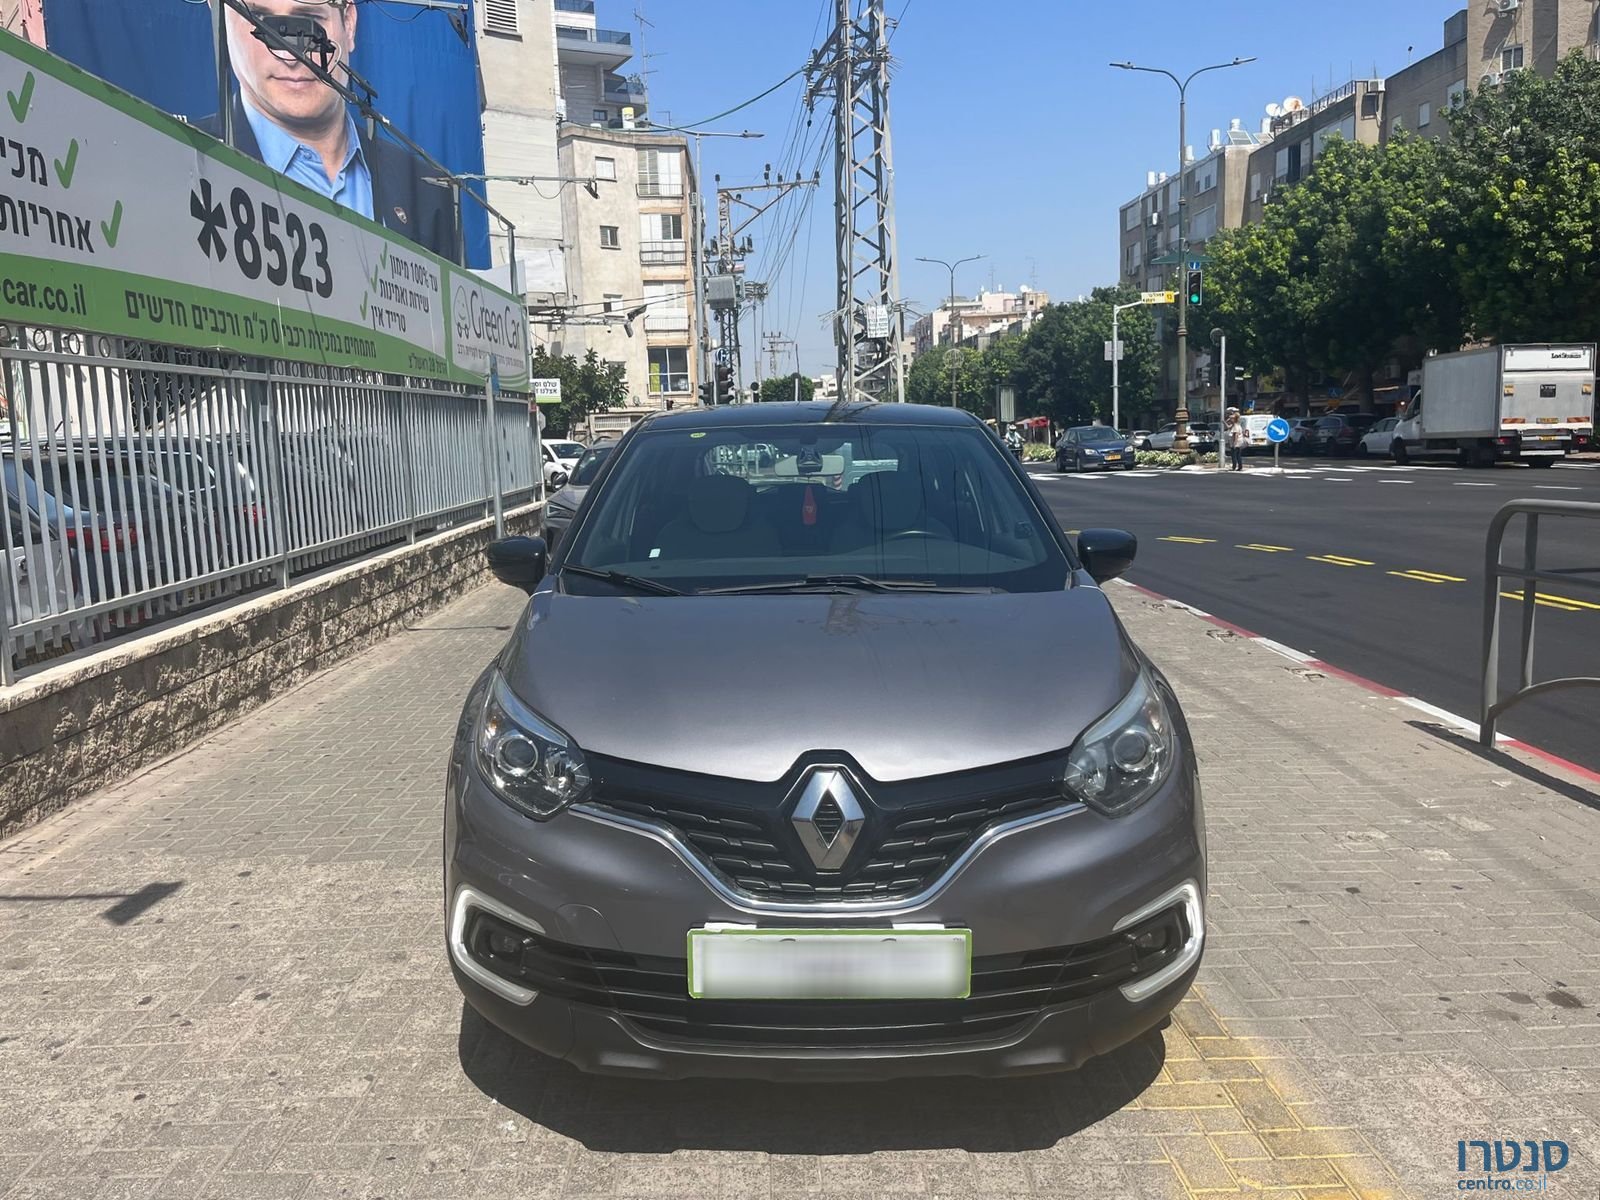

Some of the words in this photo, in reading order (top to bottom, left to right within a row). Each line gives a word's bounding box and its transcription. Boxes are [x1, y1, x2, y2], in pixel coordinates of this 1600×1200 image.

[0, 193, 95, 253] אחריות
[390, 254, 409, 280] מימון
[379, 278, 408, 307] ואמינות
[428, 273, 438, 292] עד
[0, 278, 87, 316] car.co.il
[125, 290, 188, 328] חדשים
[409, 290, 429, 314] שירות
[192, 304, 241, 337] ורכבים
[272, 317, 280, 344] 0
[371, 305, 384, 331] אין
[385, 309, 406, 333] טרייד
[470, 290, 504, 345] Green
[505, 305, 521, 350] Car
[282, 324, 305, 348] רכבי
[308, 329, 343, 355] במכירת
[344, 335, 377, 359] מתמחים
